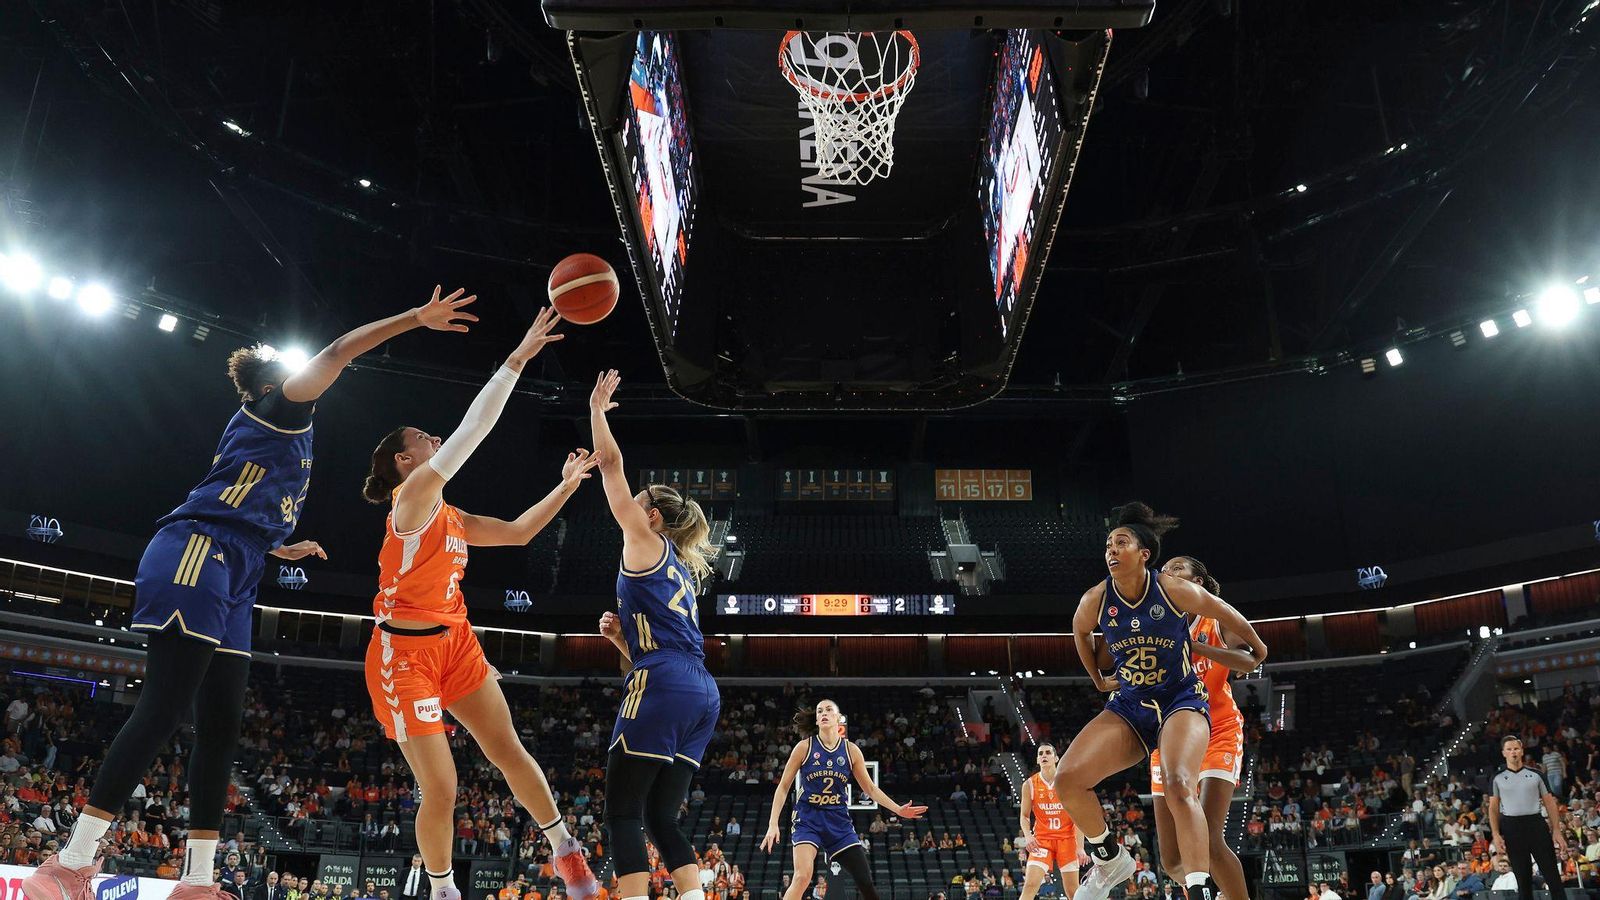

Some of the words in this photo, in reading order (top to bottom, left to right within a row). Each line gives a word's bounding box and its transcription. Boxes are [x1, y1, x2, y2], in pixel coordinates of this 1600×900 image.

[940, 484, 955, 497] 11
[963, 484, 980, 497] 15
[987, 484, 1004, 497] 17
[1014, 484, 1025, 497] 9
[764, 597, 777, 612] 0
[824, 598, 848, 608] 9:29
[894, 597, 905, 612] 2
[1125, 647, 1157, 671] 25
[1118, 666, 1167, 686] opet
[822, 777, 834, 794] 2
[808, 793, 841, 805] opet
[1048, 817, 1061, 830] 10
[323, 875, 352, 886] SALIDA
[474, 880, 504, 889] SALIDA
[102, 877, 138, 900] PULEVA
